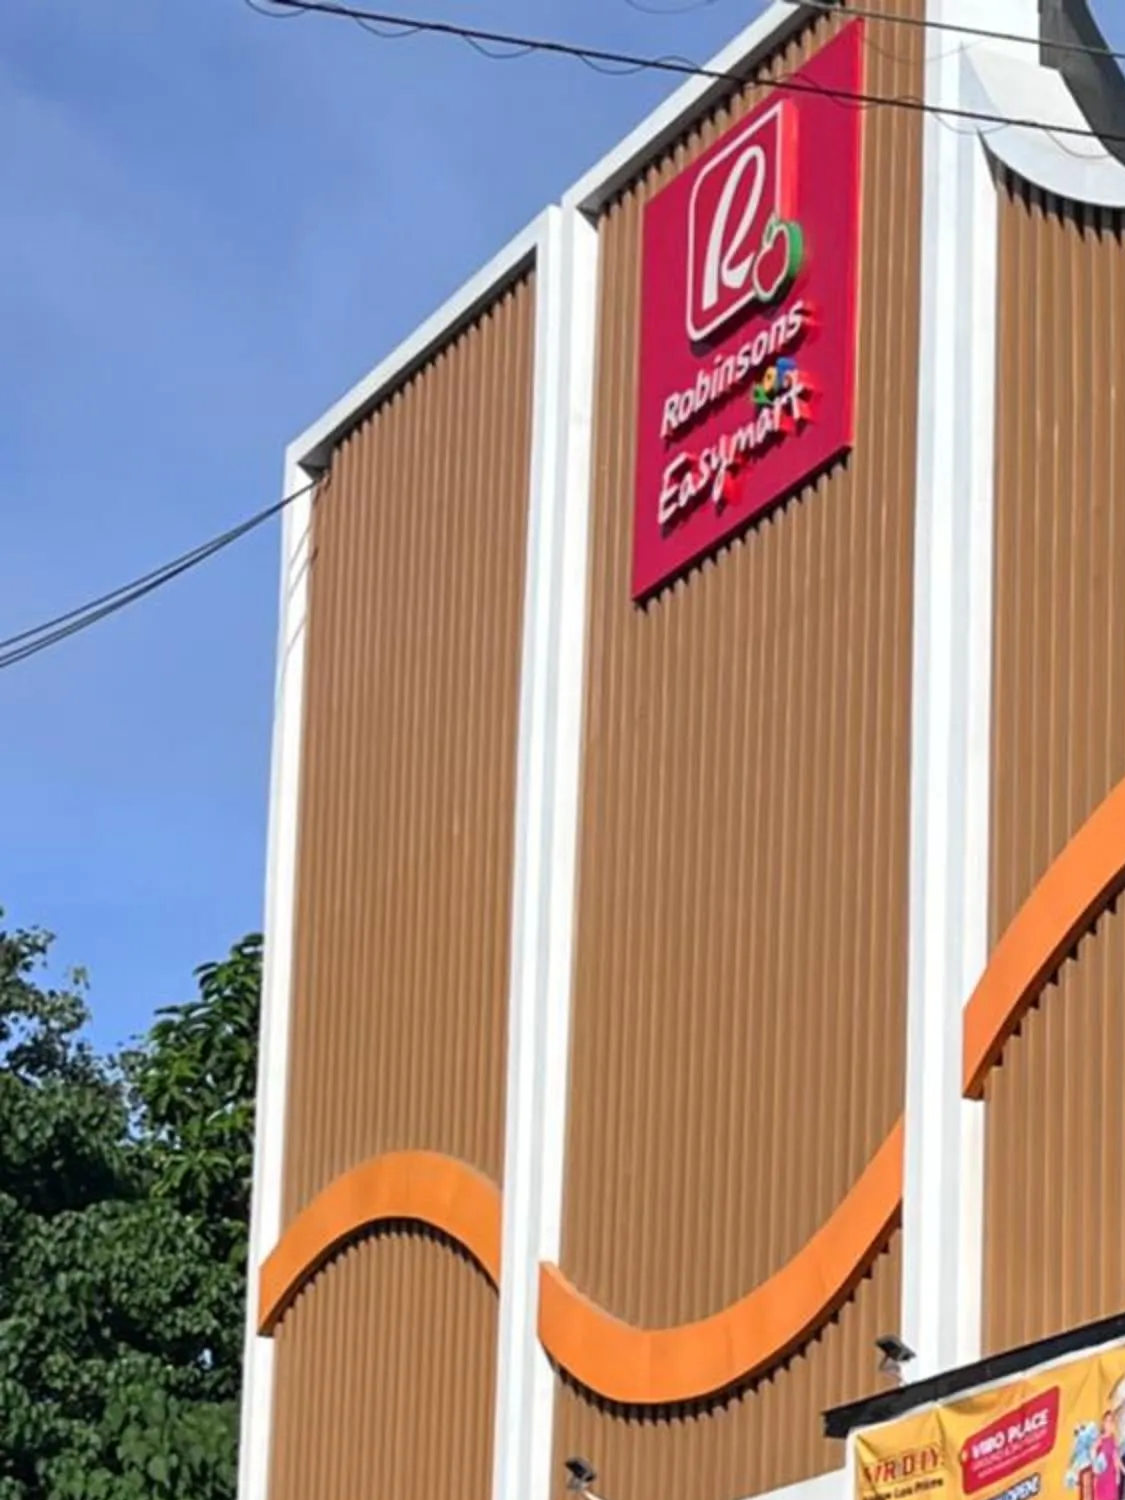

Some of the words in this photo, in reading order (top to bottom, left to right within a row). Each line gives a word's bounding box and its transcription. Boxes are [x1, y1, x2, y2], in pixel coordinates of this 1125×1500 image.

[660, 300, 804, 437] Robinsons
[657, 380, 804, 525] Easymart
[1008, 1408, 1049, 1443] PLACE
